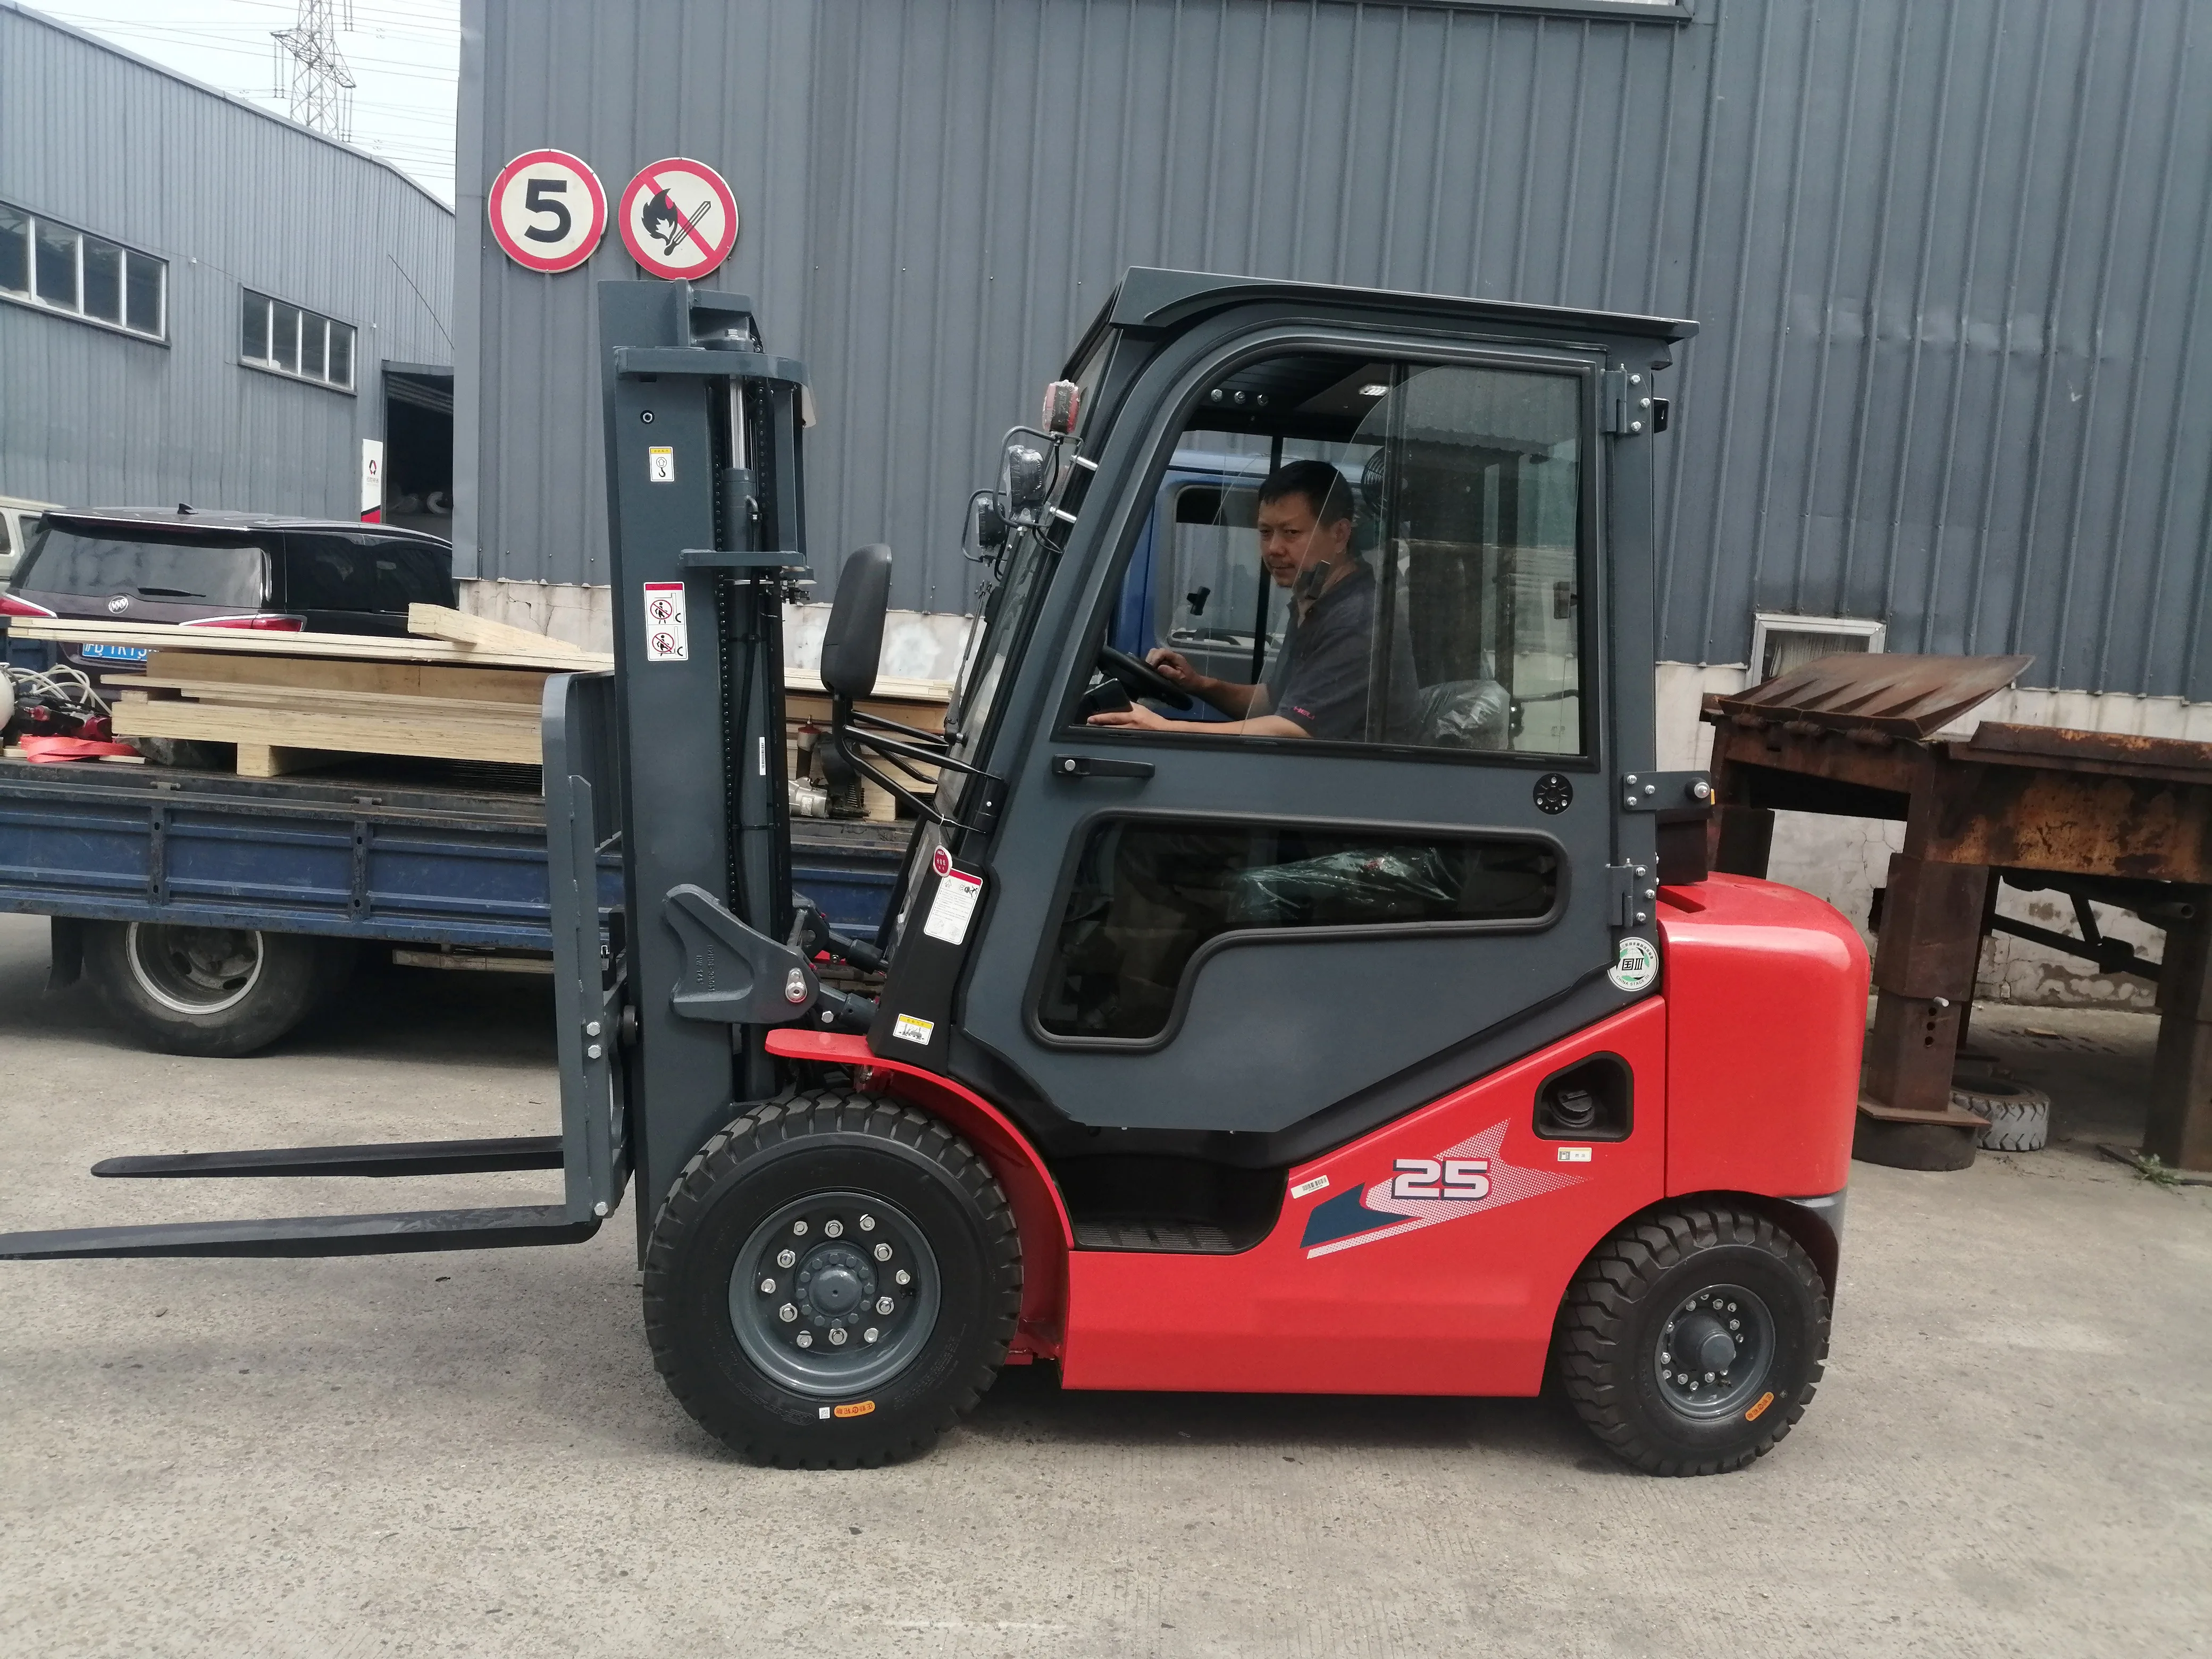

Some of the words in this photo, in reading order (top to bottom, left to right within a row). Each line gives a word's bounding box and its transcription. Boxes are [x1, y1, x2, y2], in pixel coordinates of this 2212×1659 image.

[524, 178, 572, 243] 5
[1616, 975, 1629, 985] CHINA
[1392, 1159, 1490, 1201] 25
